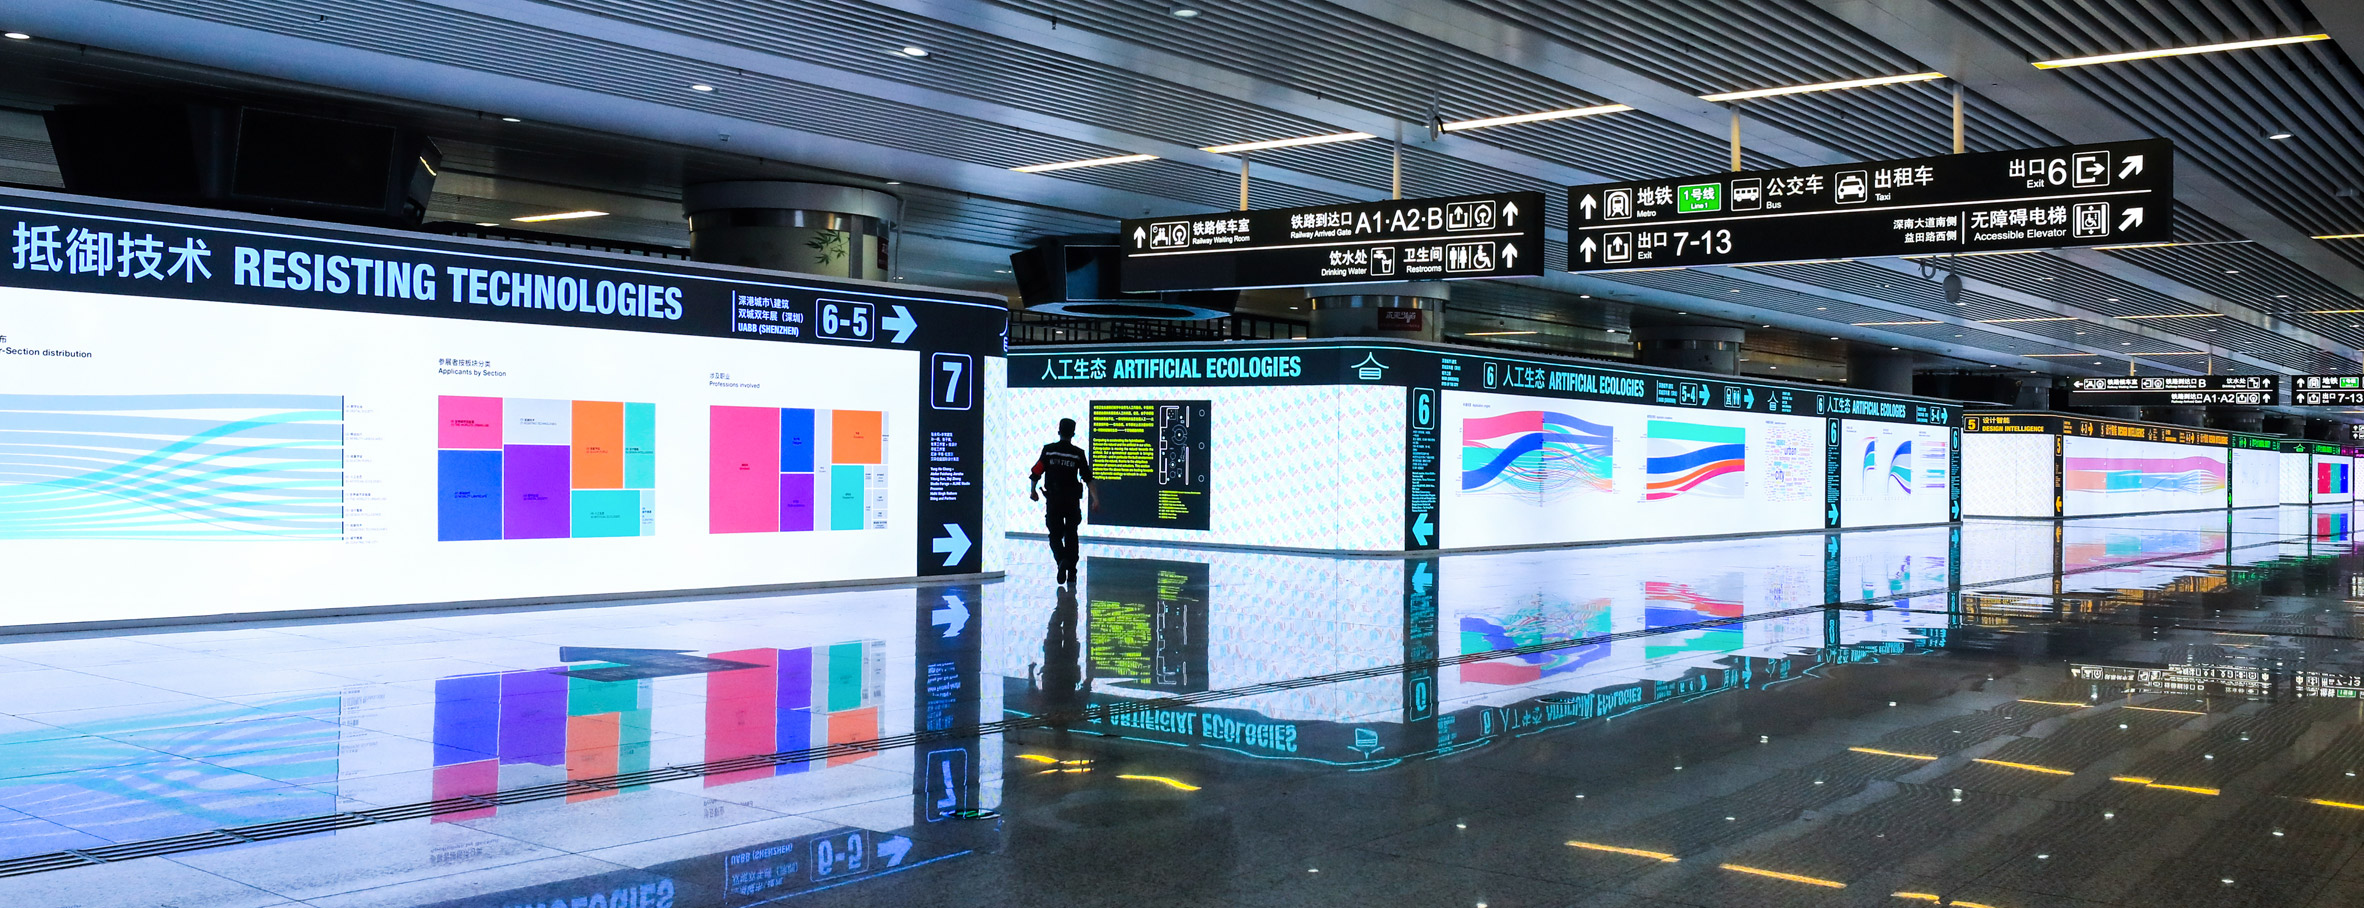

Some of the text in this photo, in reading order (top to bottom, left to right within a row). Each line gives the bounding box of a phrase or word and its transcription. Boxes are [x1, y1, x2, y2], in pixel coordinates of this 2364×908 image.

[1874, 165, 1934, 189] 出租车
[2008, 157, 2067, 185] 出口 6
[1766, 174, 1824, 197] 公交车
[2026, 179, 2045, 189] Exit
[1637, 185, 1672, 207] 地铁
[1683, 187, 1715, 201] 1号线
[1875, 193, 1891, 201] Taxi
[1690, 201, 1709, 210] Line 1
[1766, 200, 1782, 209] Bus
[1290, 211, 1352, 230] 铁路到达口
[1636, 209, 1657, 218] Metro
[1970, 206, 2067, 230] 无障碍电梯
[1192, 218, 1250, 236] 铁路候车室
[1893, 215, 1957, 231] 深南大道南侧
[1192, 235, 1250, 245] Railway Waiting Room
[1290, 228, 1352, 239] Railway Arrived Gate
[1904, 230, 1957, 244] 益田路西侧
[1973, 227, 2067, 242] Accessible Elevator
[1637, 229, 1733, 257] 出口 7-13
[1329, 249, 1368, 266] 饮水处
[1403, 246, 1443, 263] 卫生间
[1638, 251, 1653, 260] Exit
[11, 221, 684, 321] 抵御技术 RESISTING TECHNOLOGIES
[1321, 266, 1368, 278] Drinking Water
[1406, 265, 1443, 274] Restrooms
[822, 303, 868, 337] 6-5
[737, 322, 800, 338] UABB (SHENZHEN)
[42, 349, 92, 358] distribution
[438, 367, 507, 378] Applicants by Section
[1041, 355, 1302, 380] 人工生态 ARTIFICIAL ECOLOGIES
[709, 381, 740, 389] Professions
[942, 361, 963, 403] 7
[1486, 365, 1494, 386] 6
[1502, 363, 1546, 389] 人工生态
[1548, 370, 1598, 394] ARTIFICIAL
[1599, 375, 1645, 397] ECOLOGIES
[2198, 378, 2207, 388] B
[1681, 385, 1696, 403] 5-4
[2337, 393, 2364, 403] 7-13
[1418, 393, 1430, 425] 6
[1851, 400, 1880, 416] ARTIFICIAL
[1880, 402, 1907, 419] ECOLOGIES
[1830, 421, 1837, 444] 6
[1968, 419, 1976, 430] 5
[2004, 425, 2045, 433] INTELLIGENCE
[1952, 430, 1958, 448] 6
